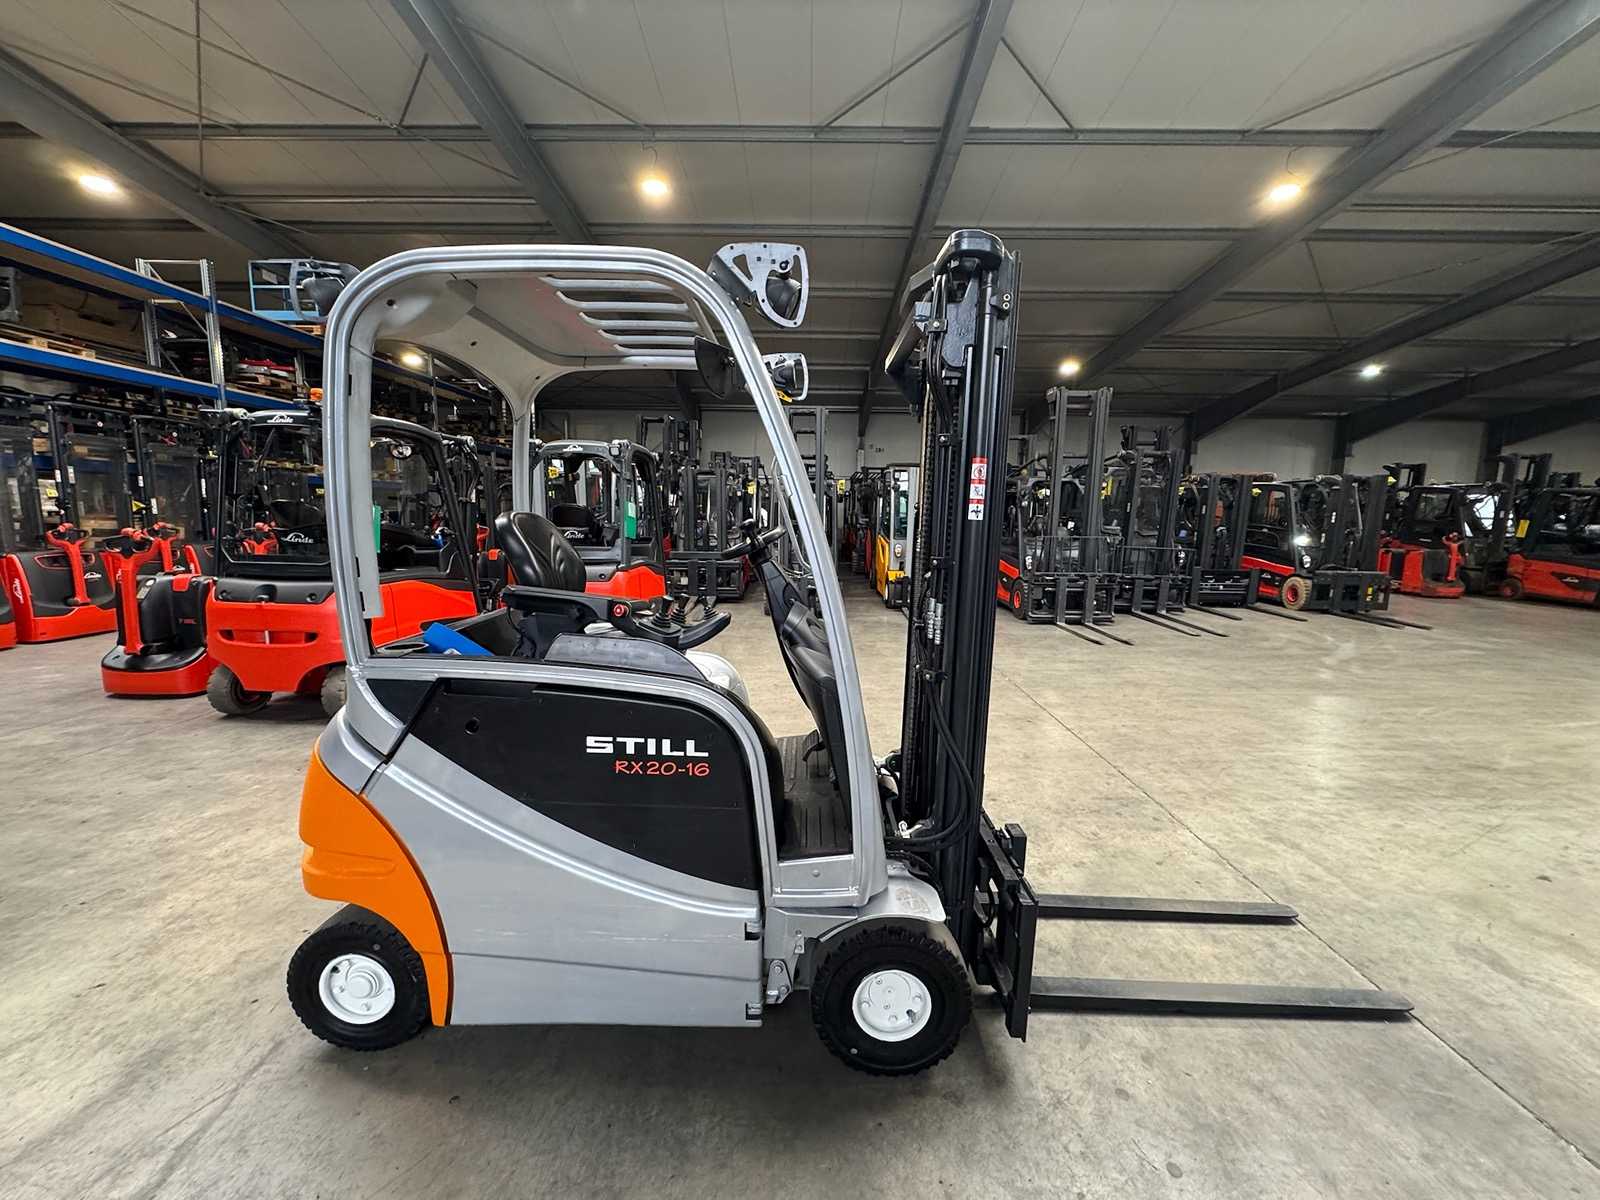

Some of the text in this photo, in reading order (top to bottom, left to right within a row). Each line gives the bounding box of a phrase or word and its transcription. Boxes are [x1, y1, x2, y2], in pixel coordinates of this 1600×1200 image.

[281, 532, 314, 544] Linde
[586, 736, 709, 757] STILL
[615, 760, 710, 776] RX20-16
